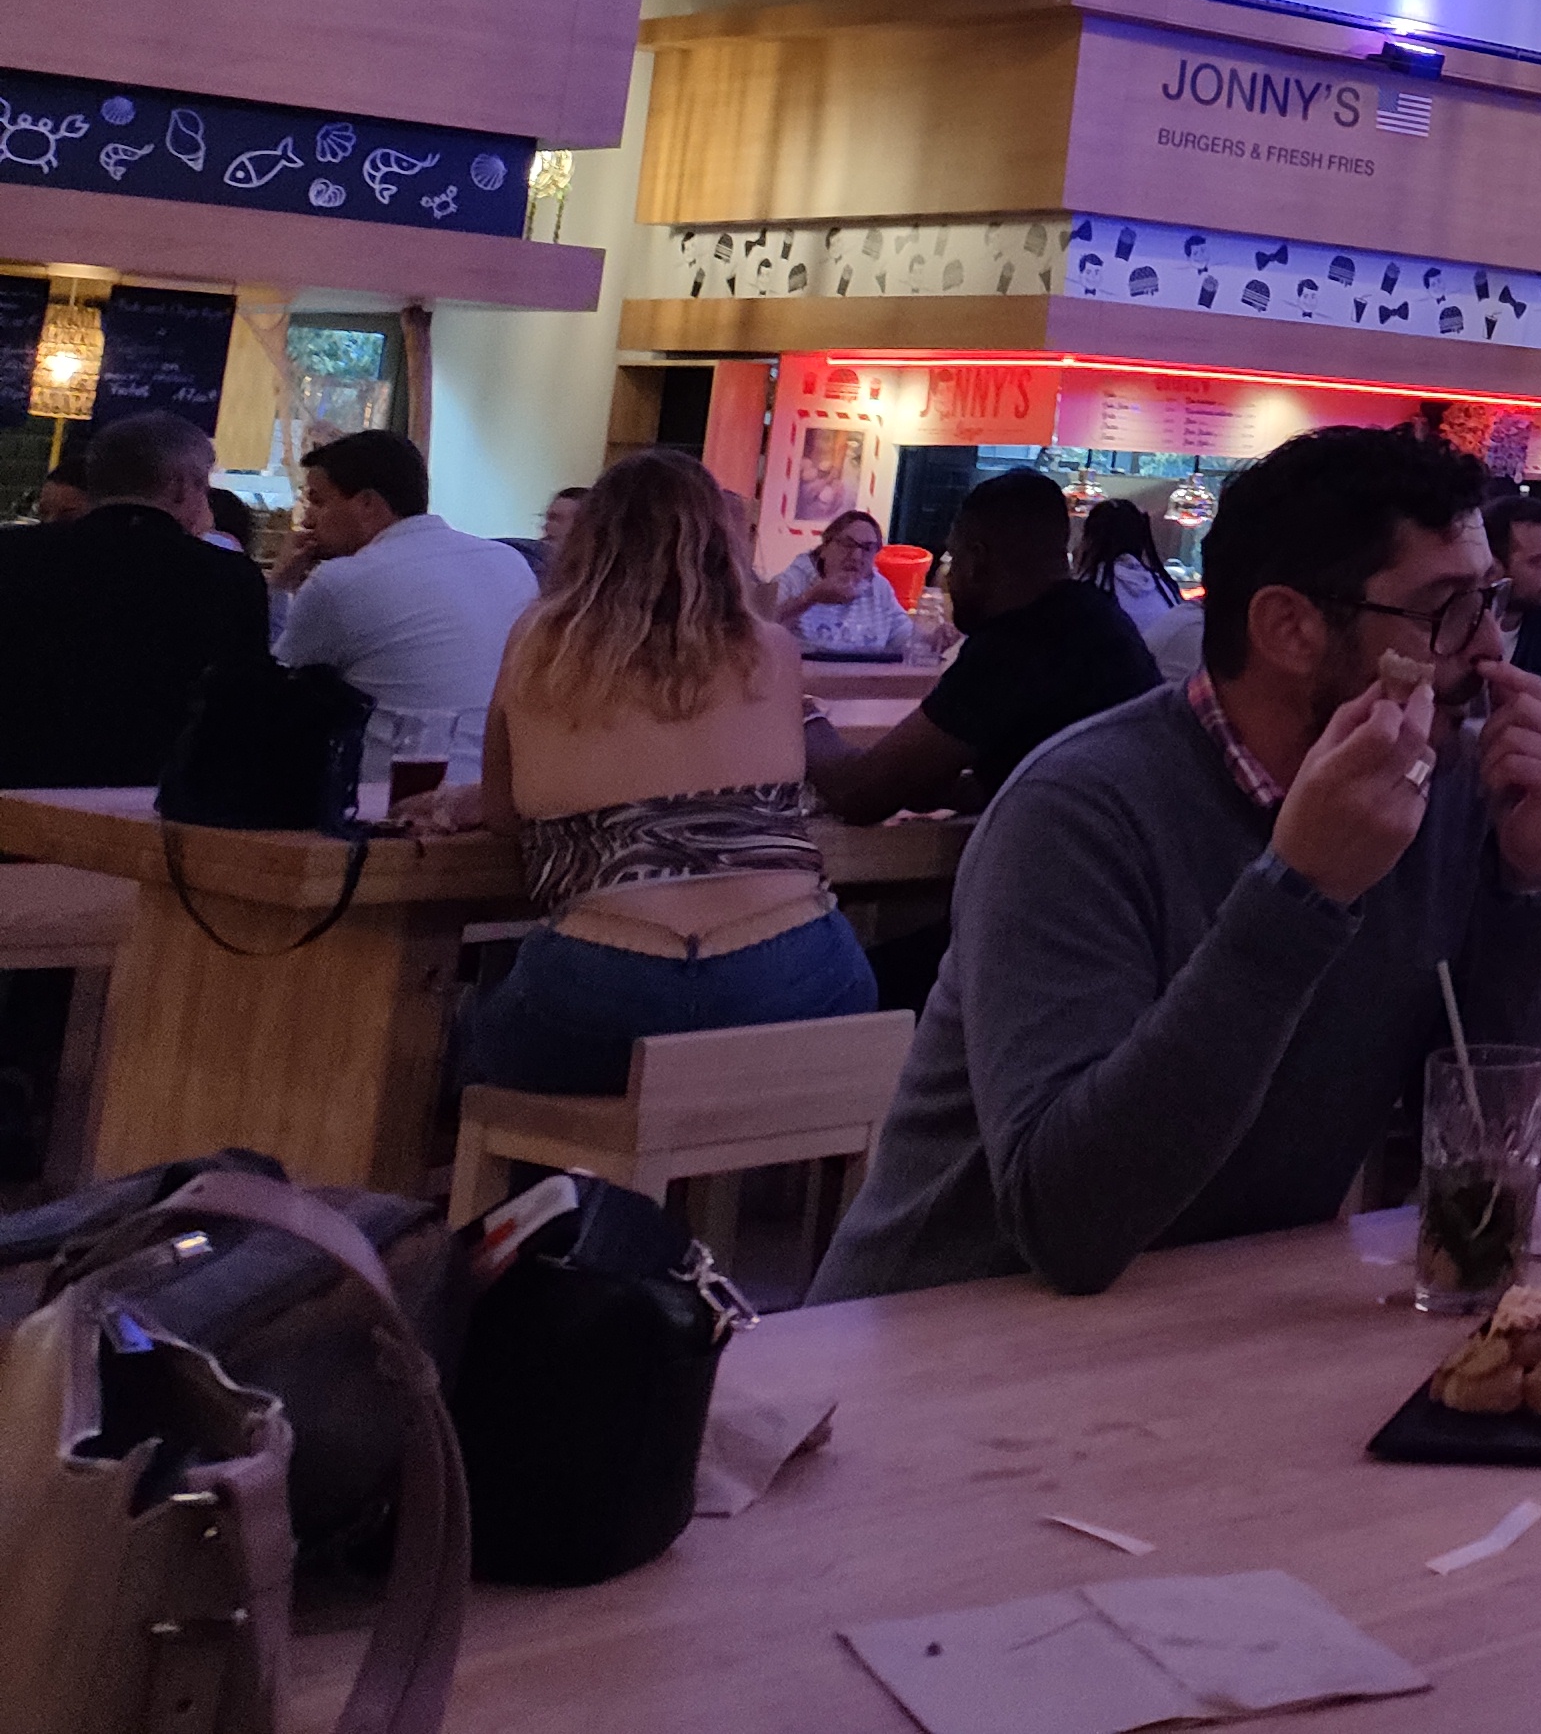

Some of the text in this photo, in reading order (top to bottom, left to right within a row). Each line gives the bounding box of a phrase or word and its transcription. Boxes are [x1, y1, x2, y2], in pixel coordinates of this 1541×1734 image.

[1162, 59, 1361, 128] JONNY'S
[1158, 127, 1376, 177] BURGERS & FRESH FRIES
